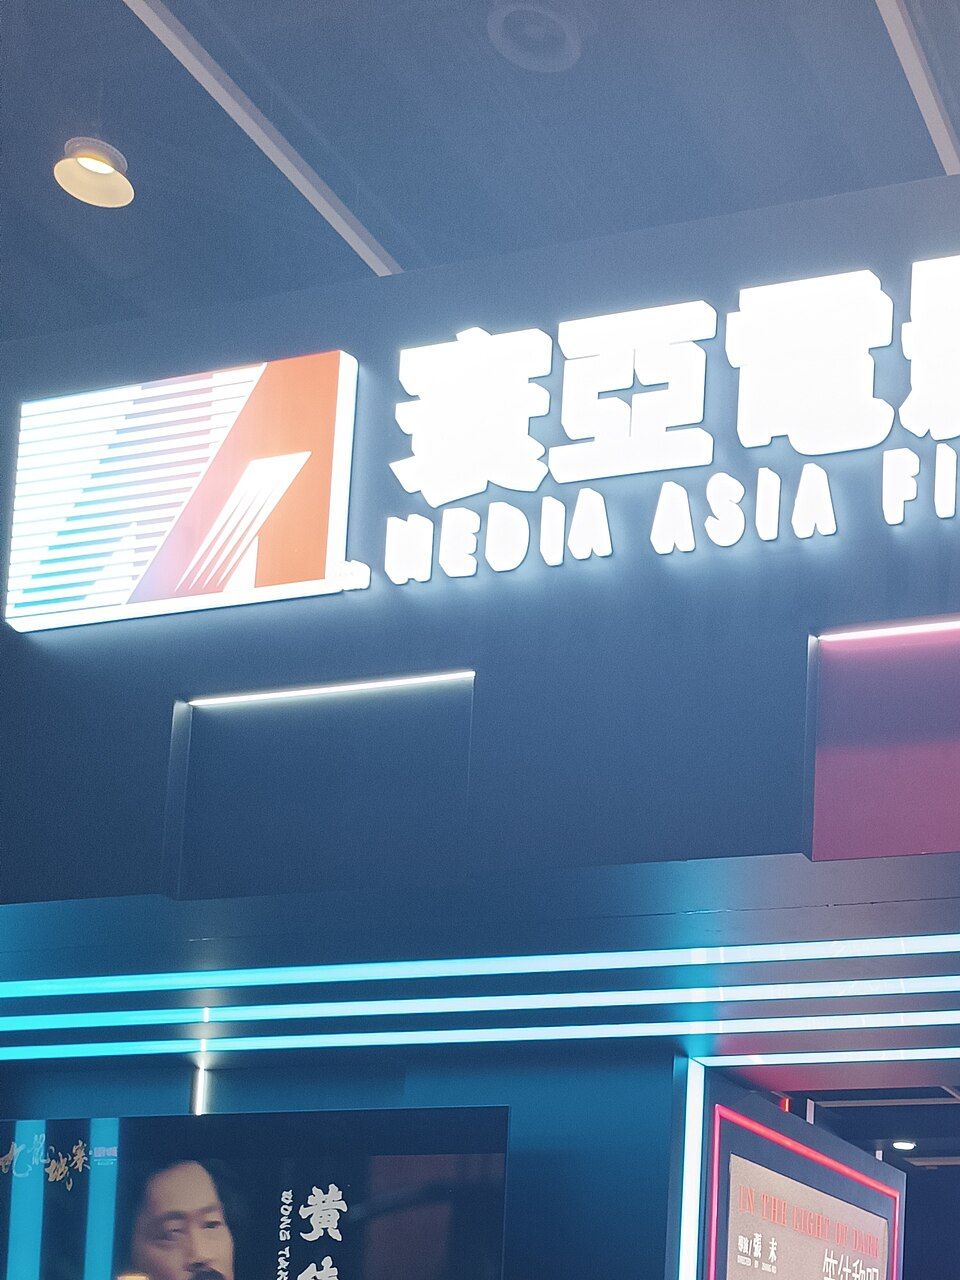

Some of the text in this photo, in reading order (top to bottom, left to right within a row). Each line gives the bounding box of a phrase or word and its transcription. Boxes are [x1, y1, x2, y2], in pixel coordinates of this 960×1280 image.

[385, 494, 613, 586] MEDIA
[649, 462, 838, 556] ASIA
[279, 1189, 293, 1242] WONG
[738, 1184, 755, 1214] IN
[760, 1193, 787, 1226] THE
